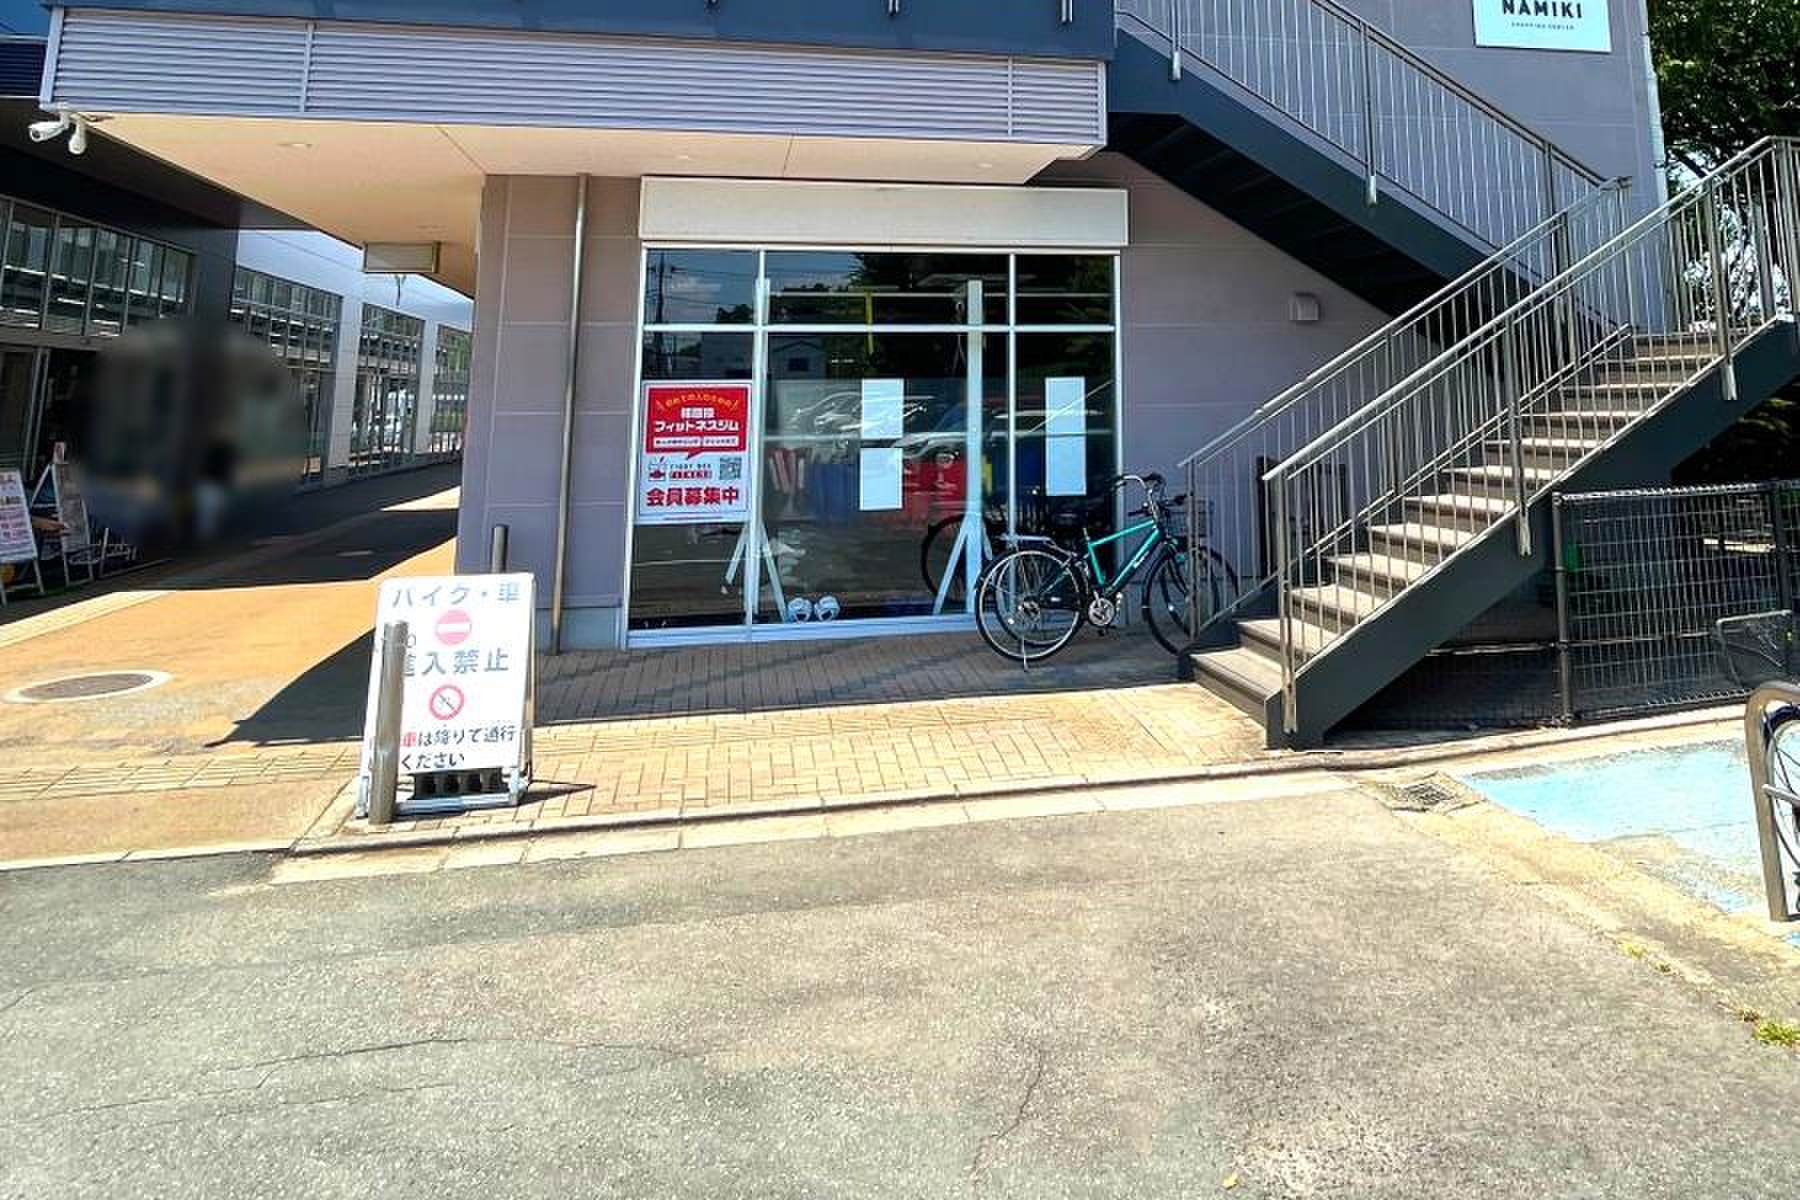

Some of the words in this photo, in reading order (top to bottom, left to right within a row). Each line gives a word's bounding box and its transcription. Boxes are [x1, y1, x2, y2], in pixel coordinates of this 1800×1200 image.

[655, 420, 740, 433] フィットネスジム
[646, 486, 739, 507] 会員募集中
